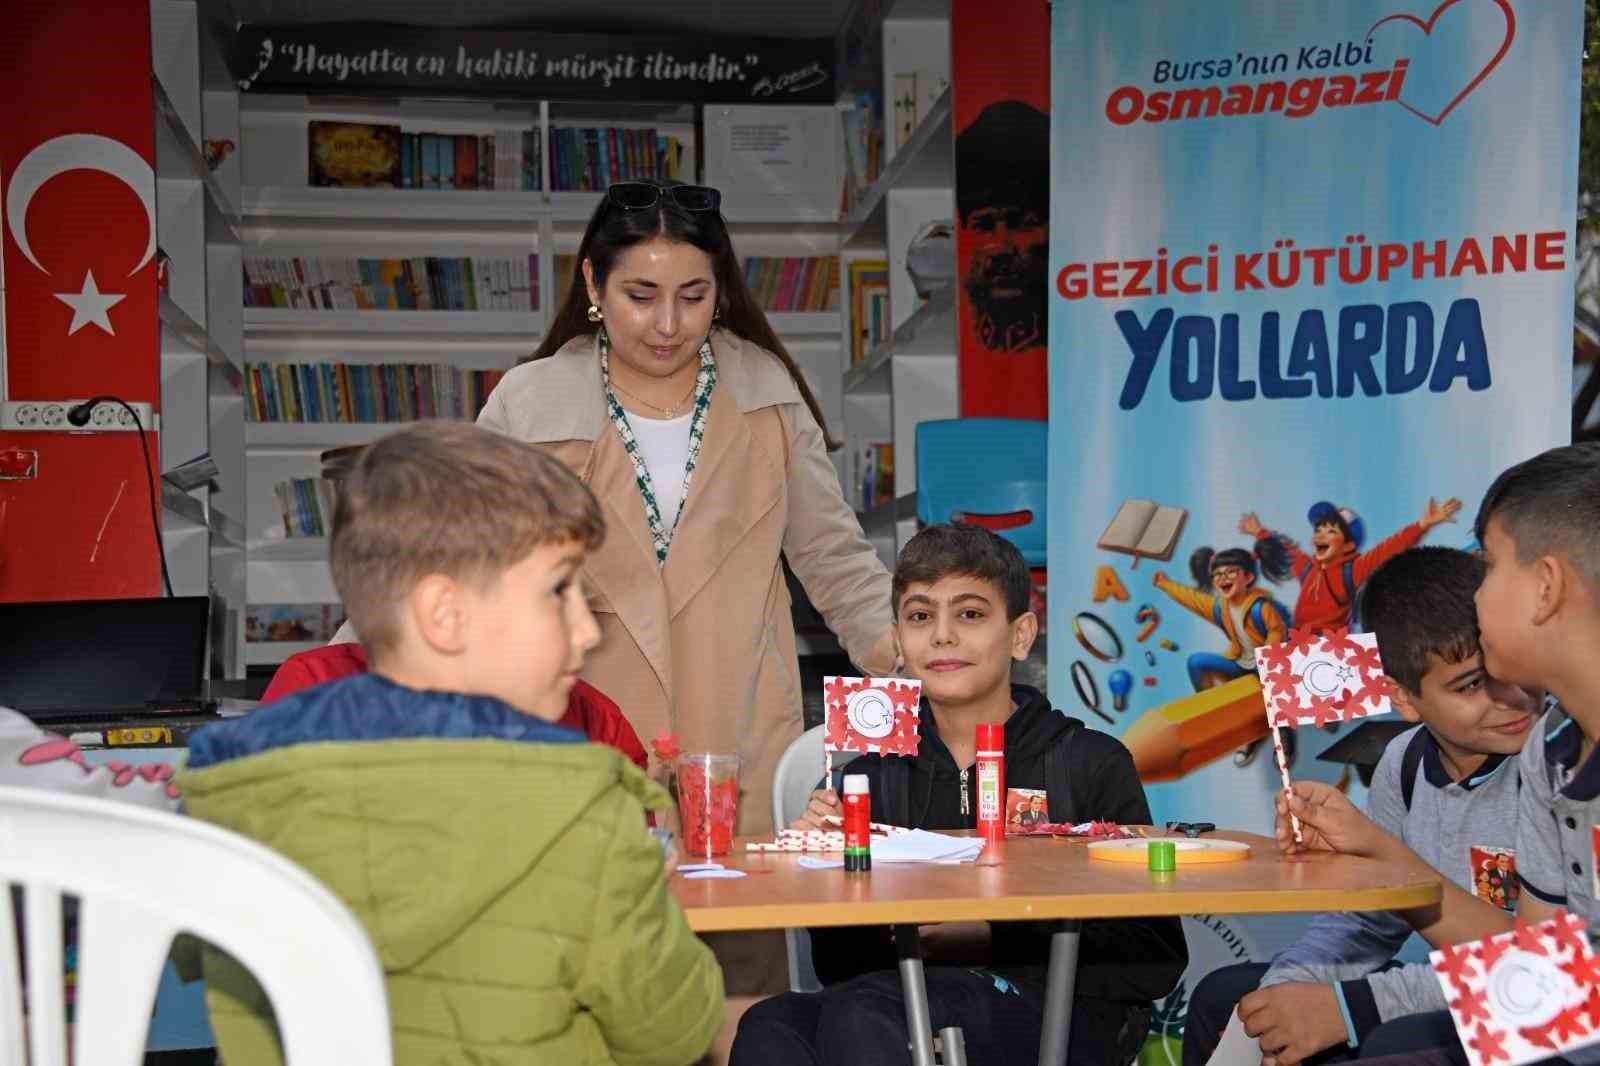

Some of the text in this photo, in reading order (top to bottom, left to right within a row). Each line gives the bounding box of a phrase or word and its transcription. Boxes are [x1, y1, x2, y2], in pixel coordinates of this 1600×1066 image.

[415, 54, 447, 77] en
[455, 45, 538, 80] hakiki
[545, 53, 634, 88] mürşit
[1296, 38, 1374, 71] Kalbi
[1104, 57, 1411, 126] Osmangazi
[1056, 231, 1567, 300] GEZİCİ KÜTÜPHANE
[1114, 298, 1492, 411] YOLLARDA
